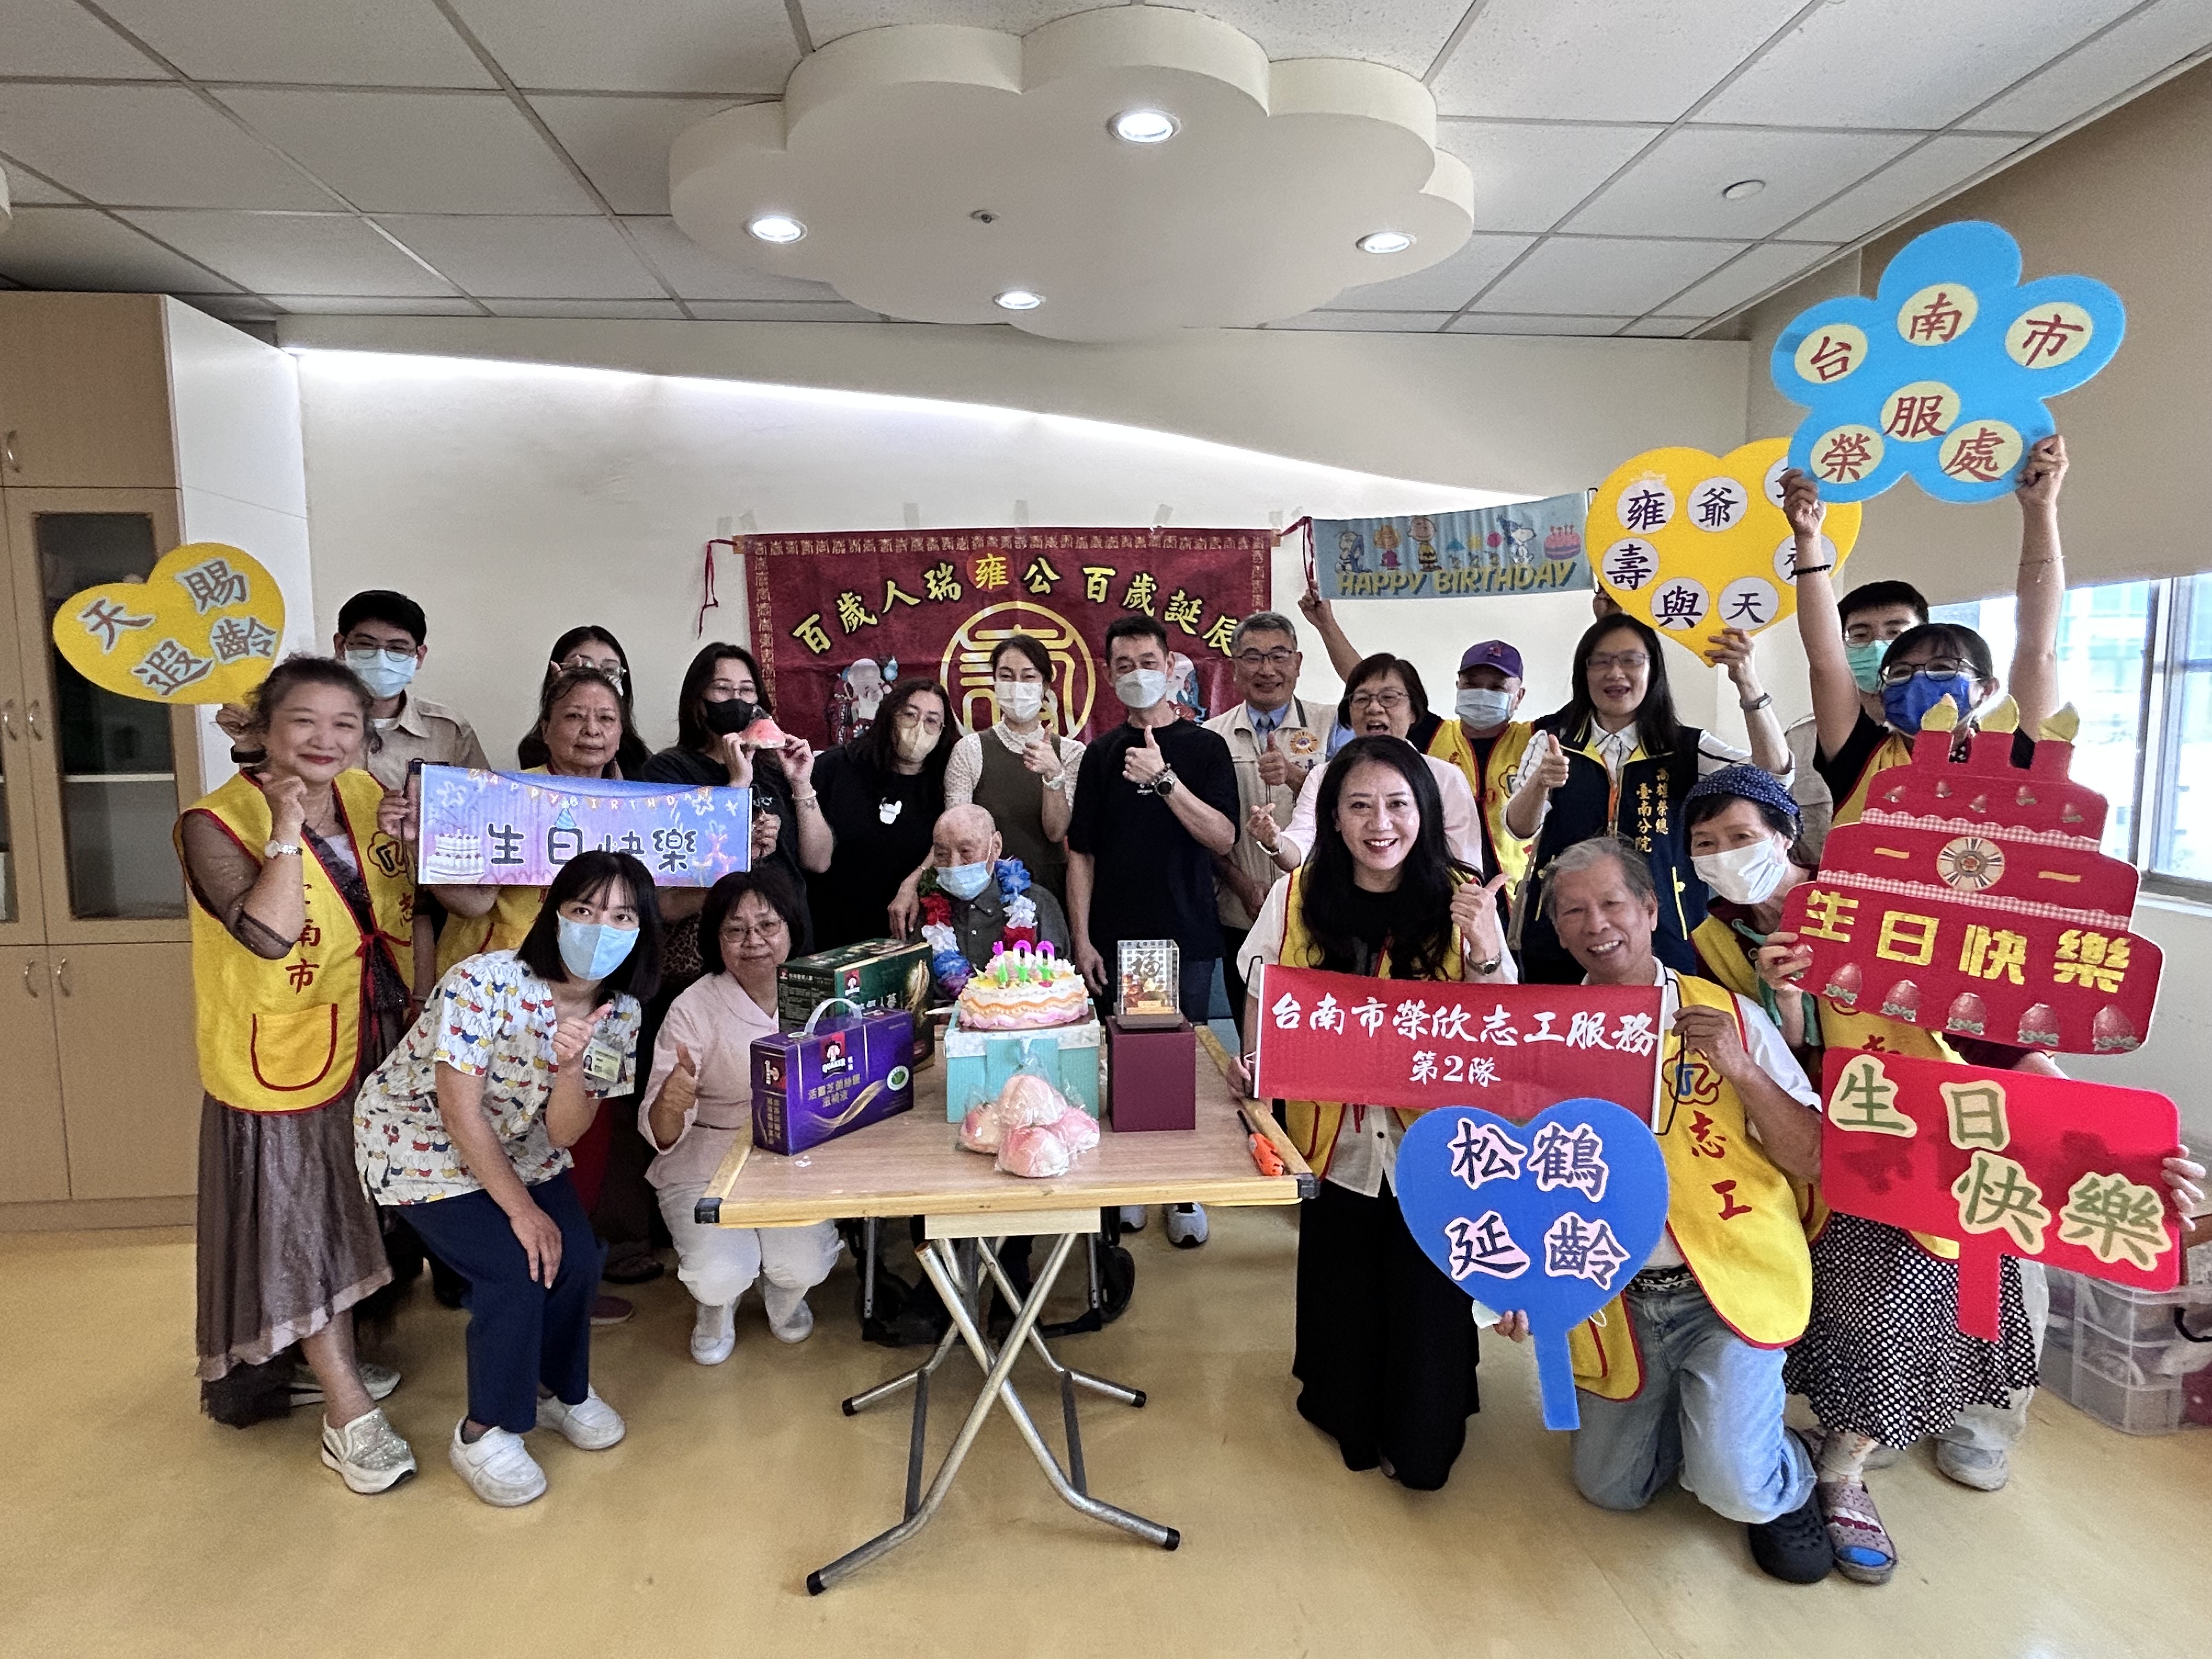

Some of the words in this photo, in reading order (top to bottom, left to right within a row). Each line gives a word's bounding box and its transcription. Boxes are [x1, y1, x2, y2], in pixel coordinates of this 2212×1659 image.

[1810, 292, 2084, 383] 台南市
[1820, 393, 2006, 483] 榮服處
[81, 560, 248, 650] 天賜
[1336, 569, 1428, 596] HAPPY
[1434, 561, 1577, 594] BIRTHDAY
[134, 617, 276, 696] 遐齡
[1799, 889, 2132, 994] 生日快樂
[822, 1058, 846, 1073] QUAKER
[1271, 992, 1658, 1057] 台南市榮欣志工服務
[1409, 1050, 1502, 1087] 第2隊
[1836, 1063, 2007, 1148] 生日
[1453, 1122, 1604, 1198] 松鶴
[1689, 1110, 1752, 1221] 志工
[1451, 1216, 1626, 1284] 延齡
[1957, 1155, 2160, 1266] 快樂
